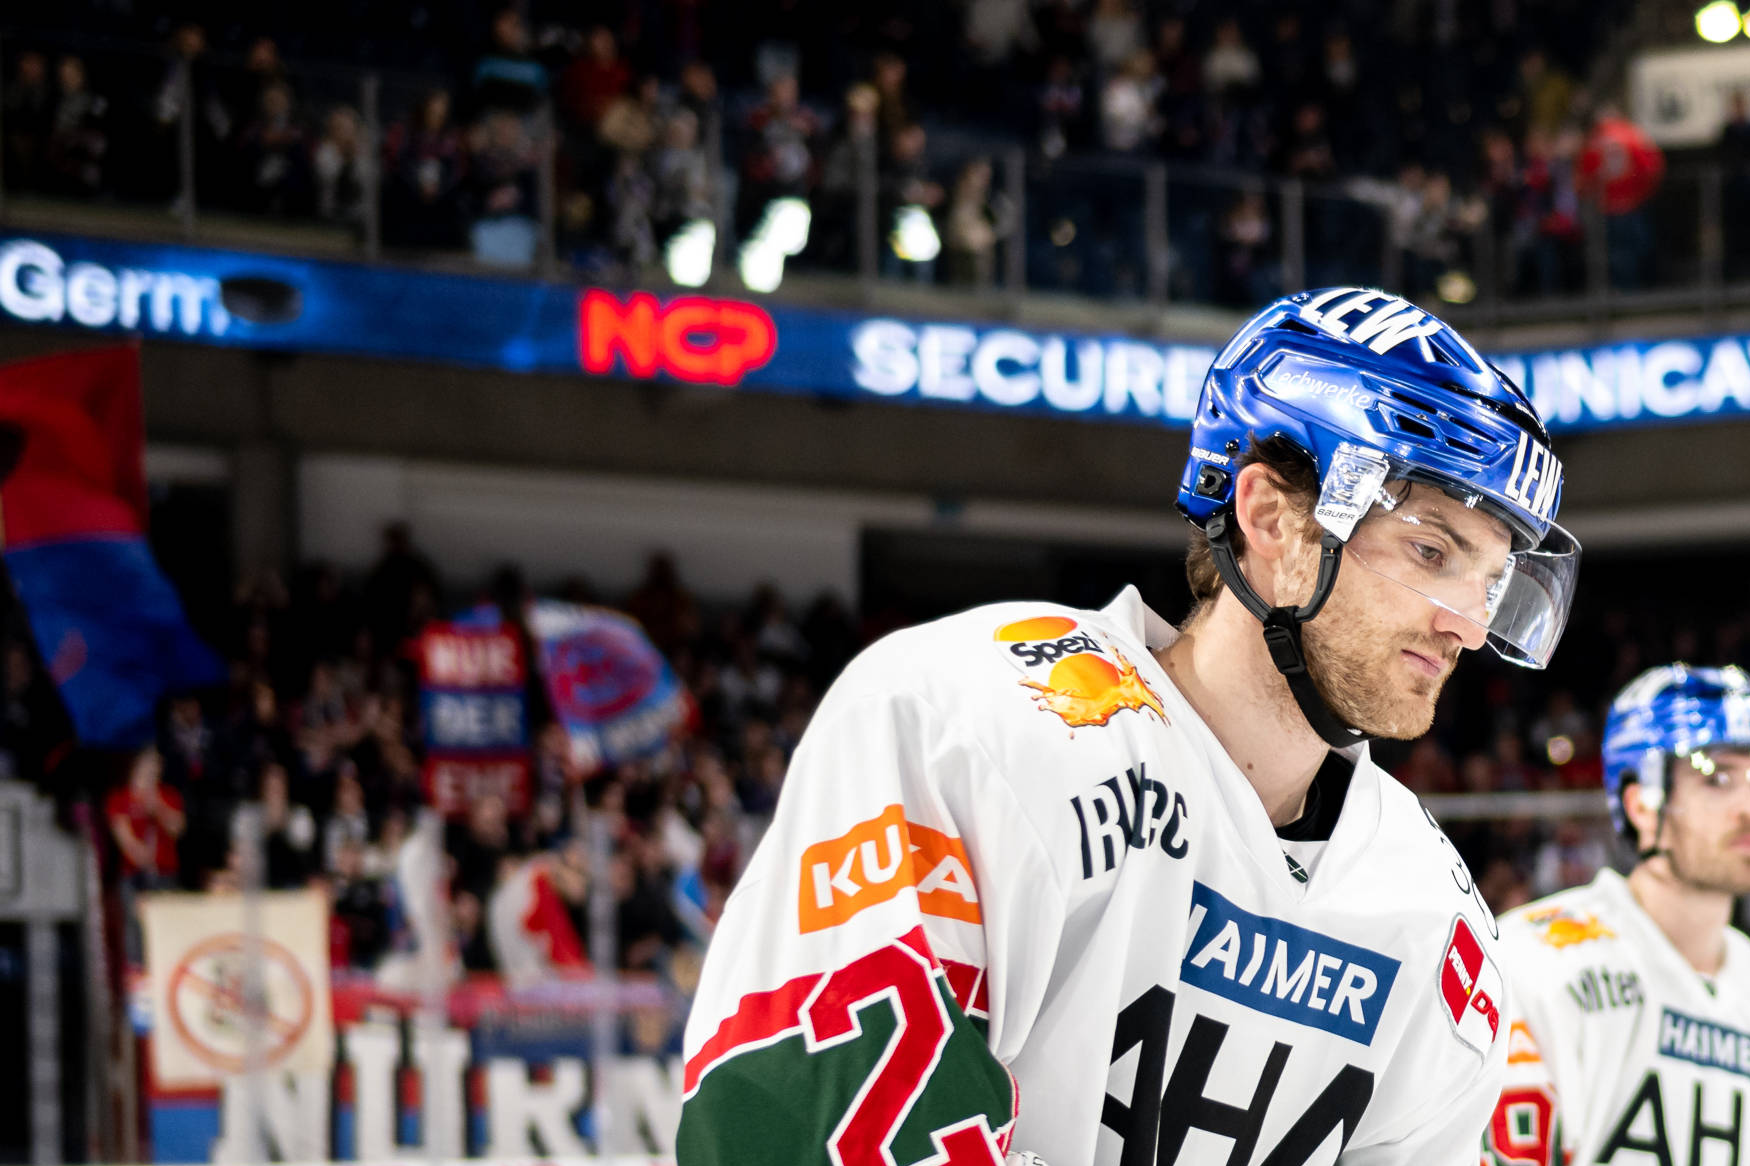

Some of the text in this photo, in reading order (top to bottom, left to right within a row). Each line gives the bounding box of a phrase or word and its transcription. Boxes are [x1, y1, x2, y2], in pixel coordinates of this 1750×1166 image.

[850, 316, 1214, 422] SECURE
[1266, 365, 1374, 411] Lechwerke
[1504, 429, 1564, 521] LEW
[1009, 631, 1102, 668] Spezi
[810, 822, 980, 910] KUA
